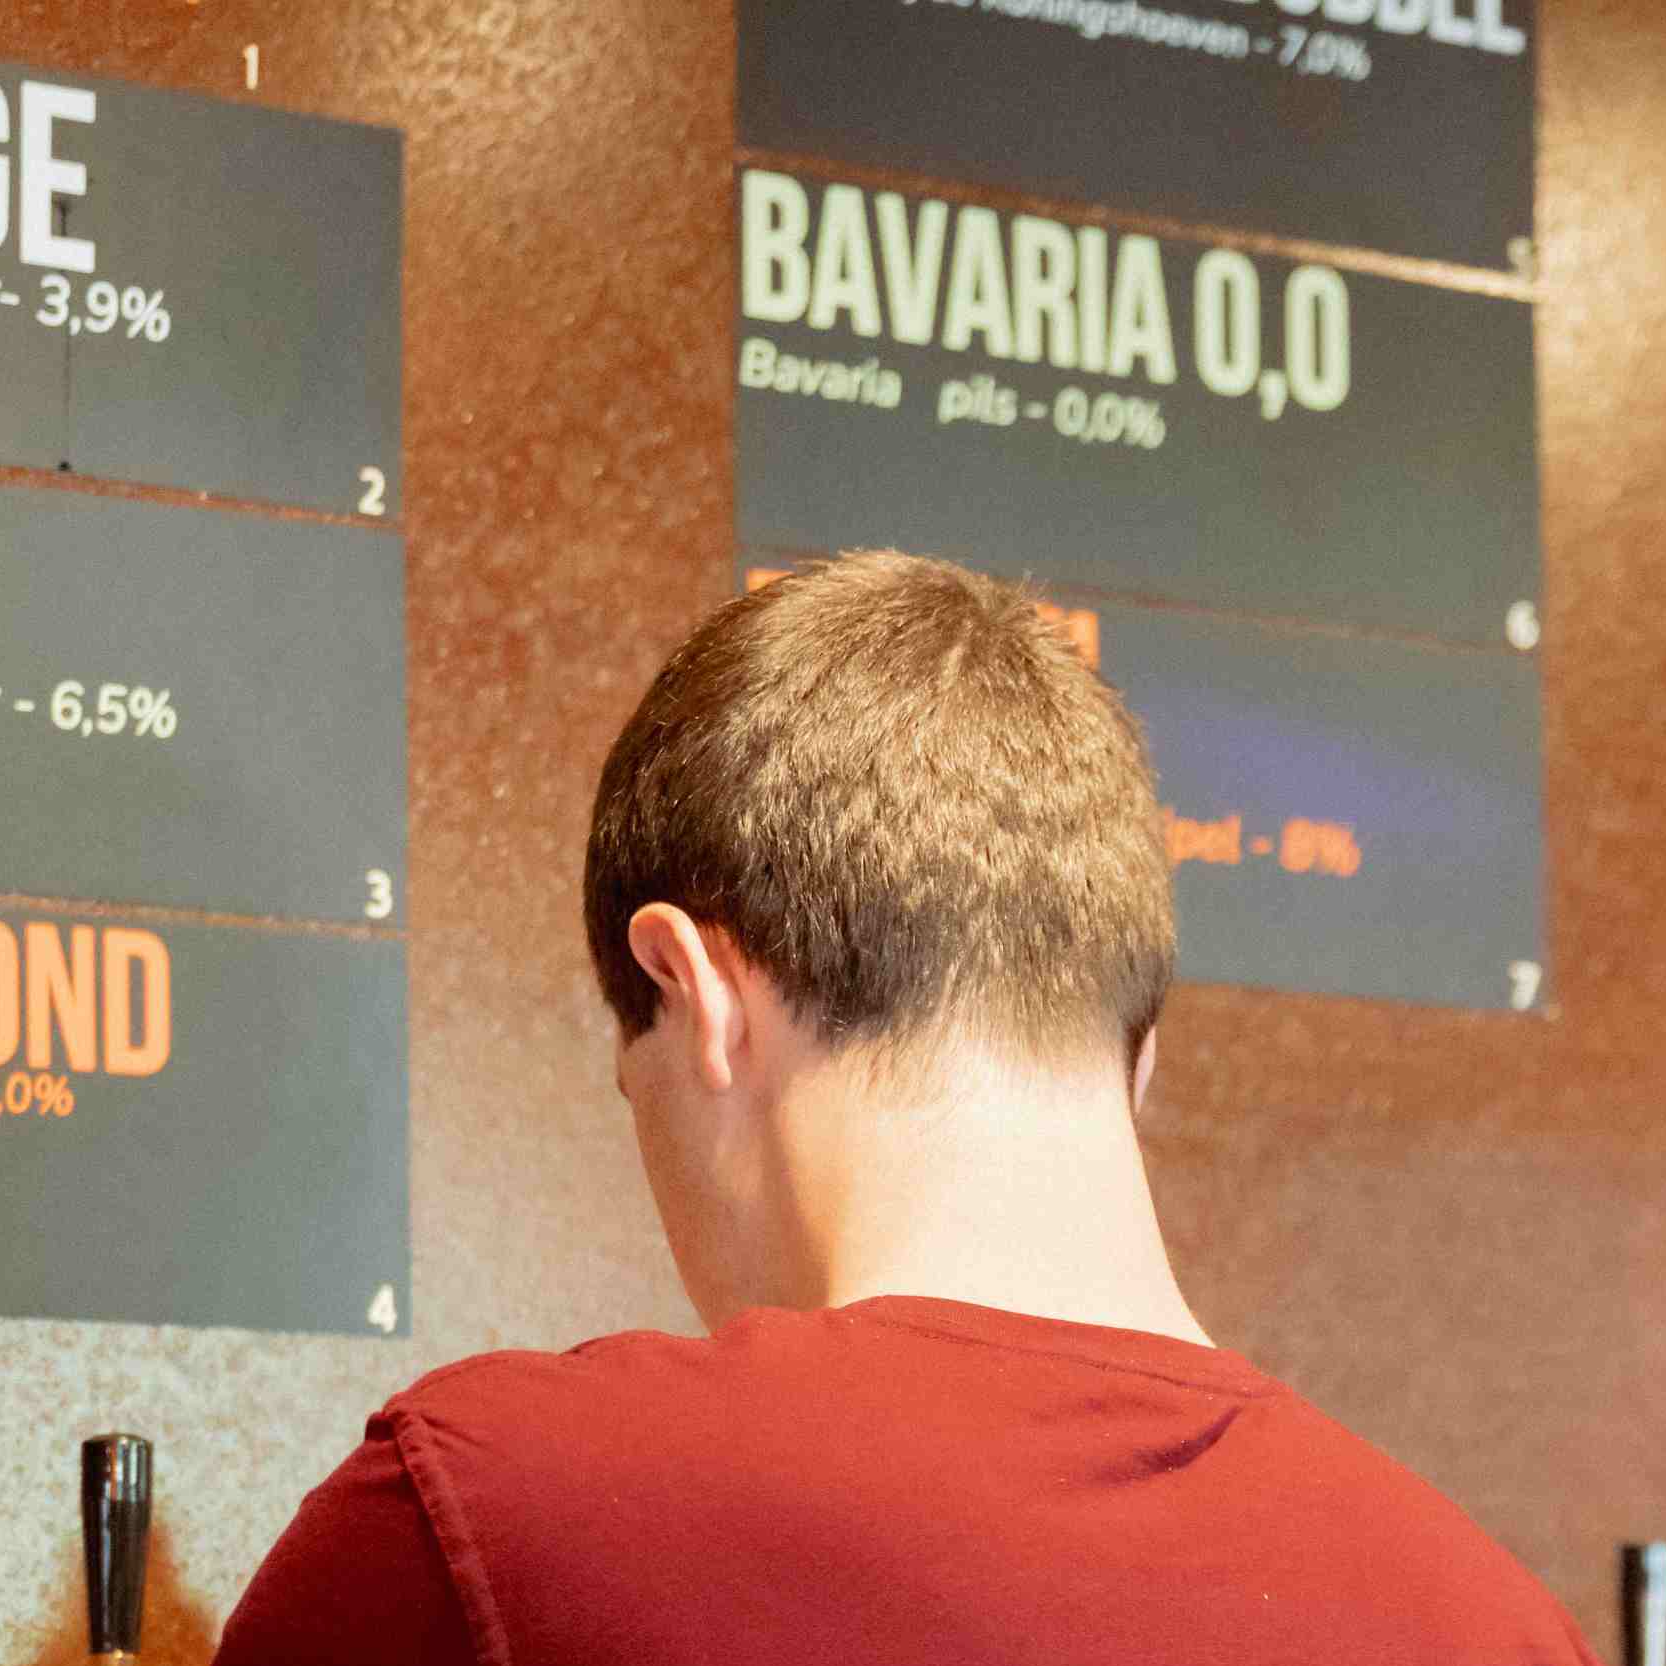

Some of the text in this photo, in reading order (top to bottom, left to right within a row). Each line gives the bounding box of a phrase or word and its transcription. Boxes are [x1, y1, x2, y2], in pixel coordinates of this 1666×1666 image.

[243, 43, 260, 91] 1
[36, 274, 171, 342] 3,9%
[742, 168, 1351, 420] BAVARIA 0,0
[739, 337, 902, 409] Bavaria
[937, 374, 1018, 427] pils
[1053, 386, 1166, 450] 0,0%
[357, 468, 385, 516] 2
[50, 680, 178, 739] 6,5%
[365, 870, 393, 920] 3
[368, 1284, 397, 1333] 4
